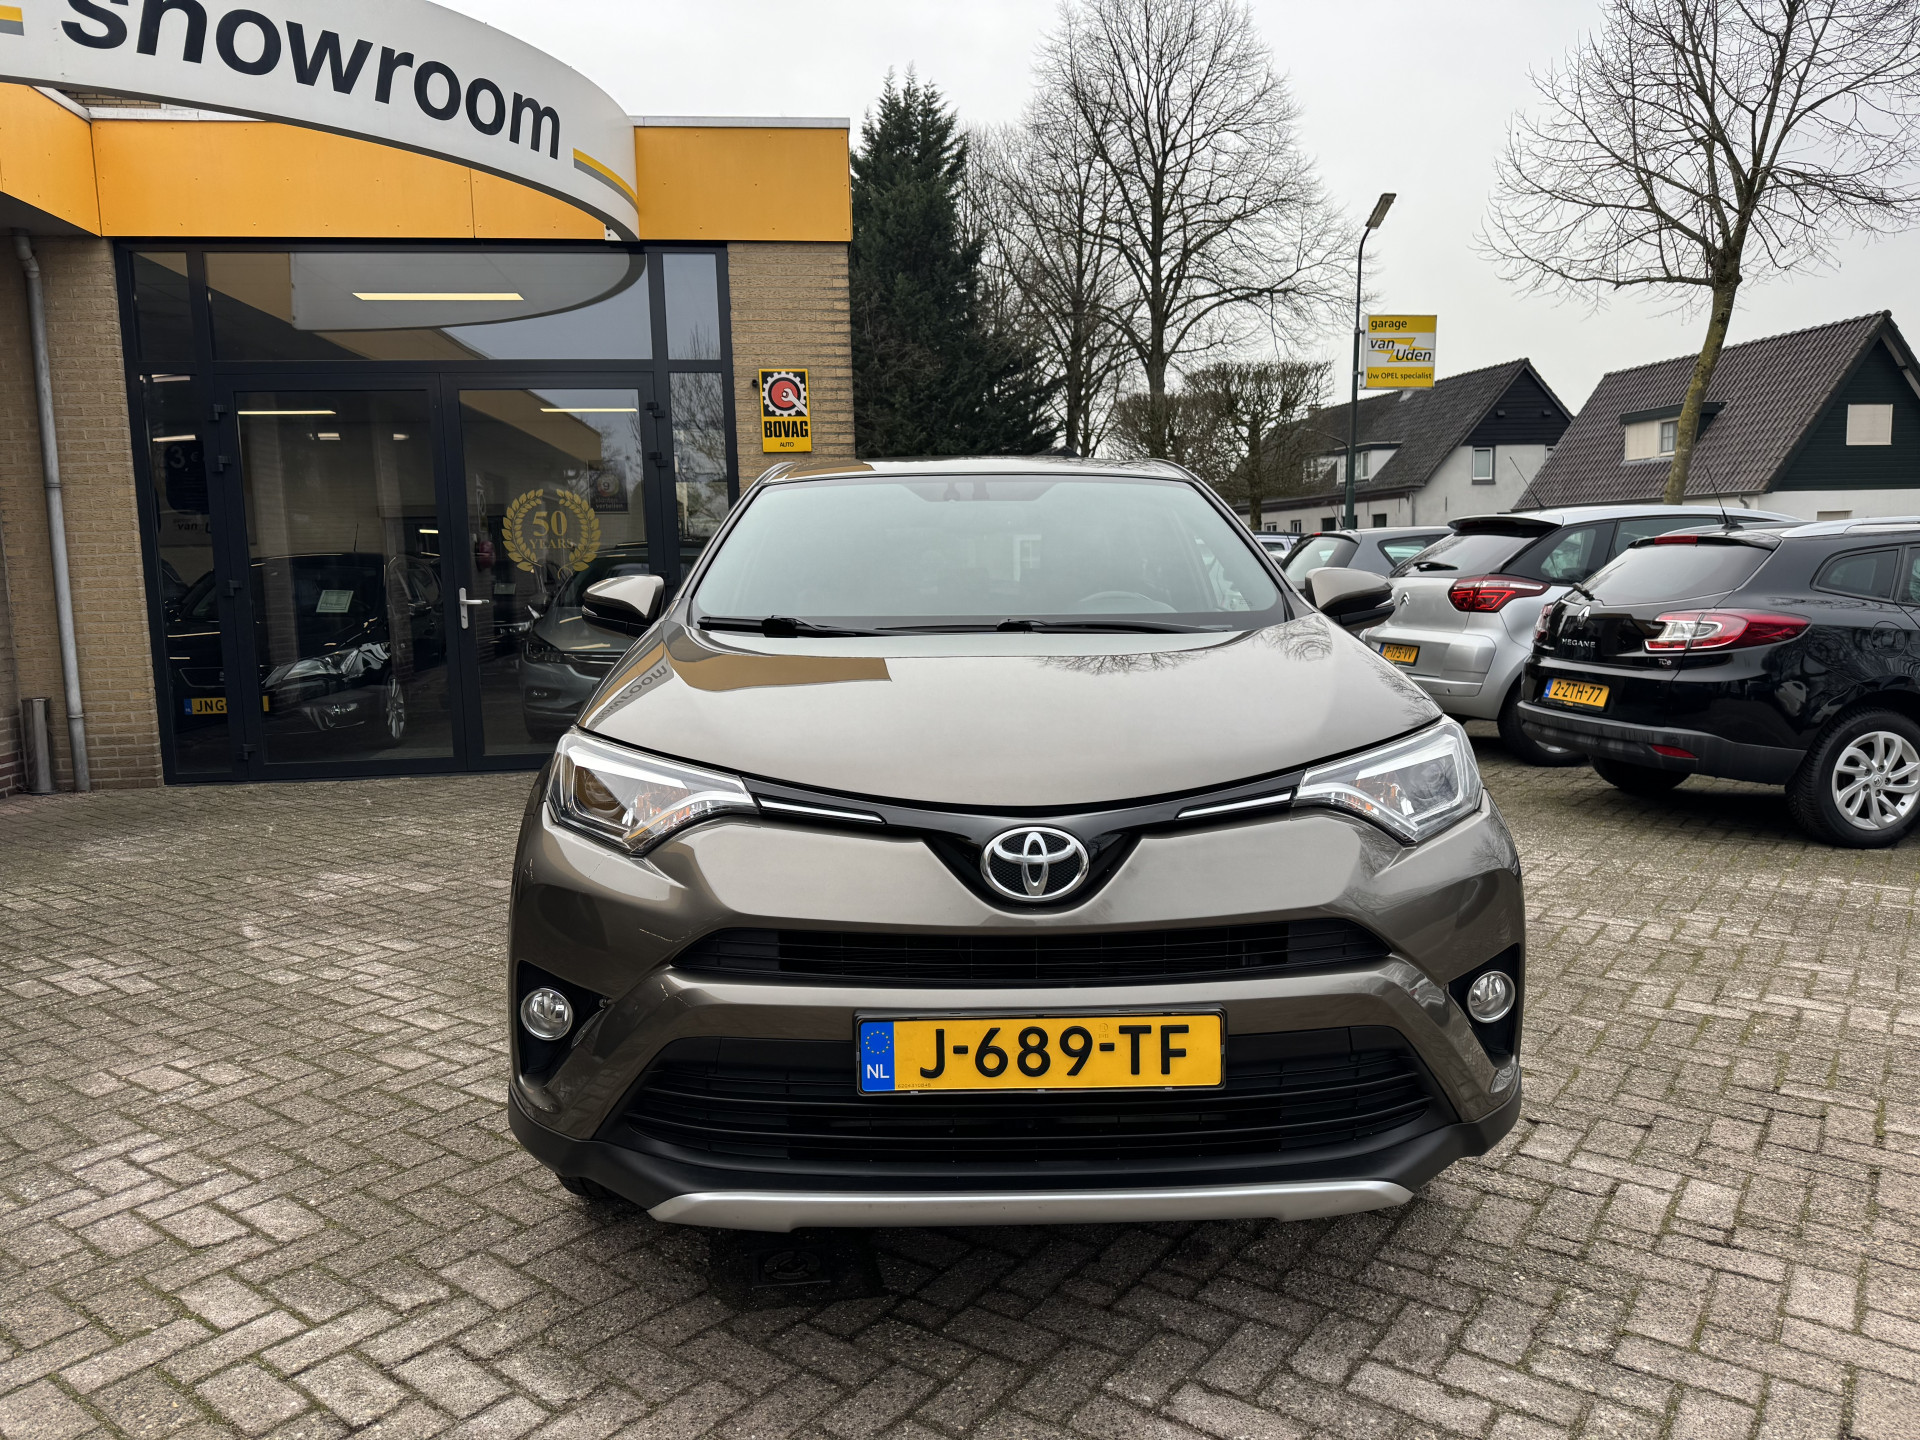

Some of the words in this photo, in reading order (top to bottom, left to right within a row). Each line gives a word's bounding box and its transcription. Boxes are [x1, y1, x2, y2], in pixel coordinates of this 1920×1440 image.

[60, 0, 561, 160] showroom
[1371, 320, 1407, 330] garage
[1370, 340, 1395, 349] van
[1395, 348, 1432, 361] Uden
[1400, 372, 1432, 380] specialist
[763, 421, 808, 438] BOVAG
[532, 510, 568, 537] 50
[529, 538, 574, 549] YEARS
[1561, 638, 1597, 648] MEGANE
[1553, 681, 1604, 703] 2-ZTH-77
[866, 1064, 890, 1079] NL
[919, 1024, 1190, 1079] J-689-TF
